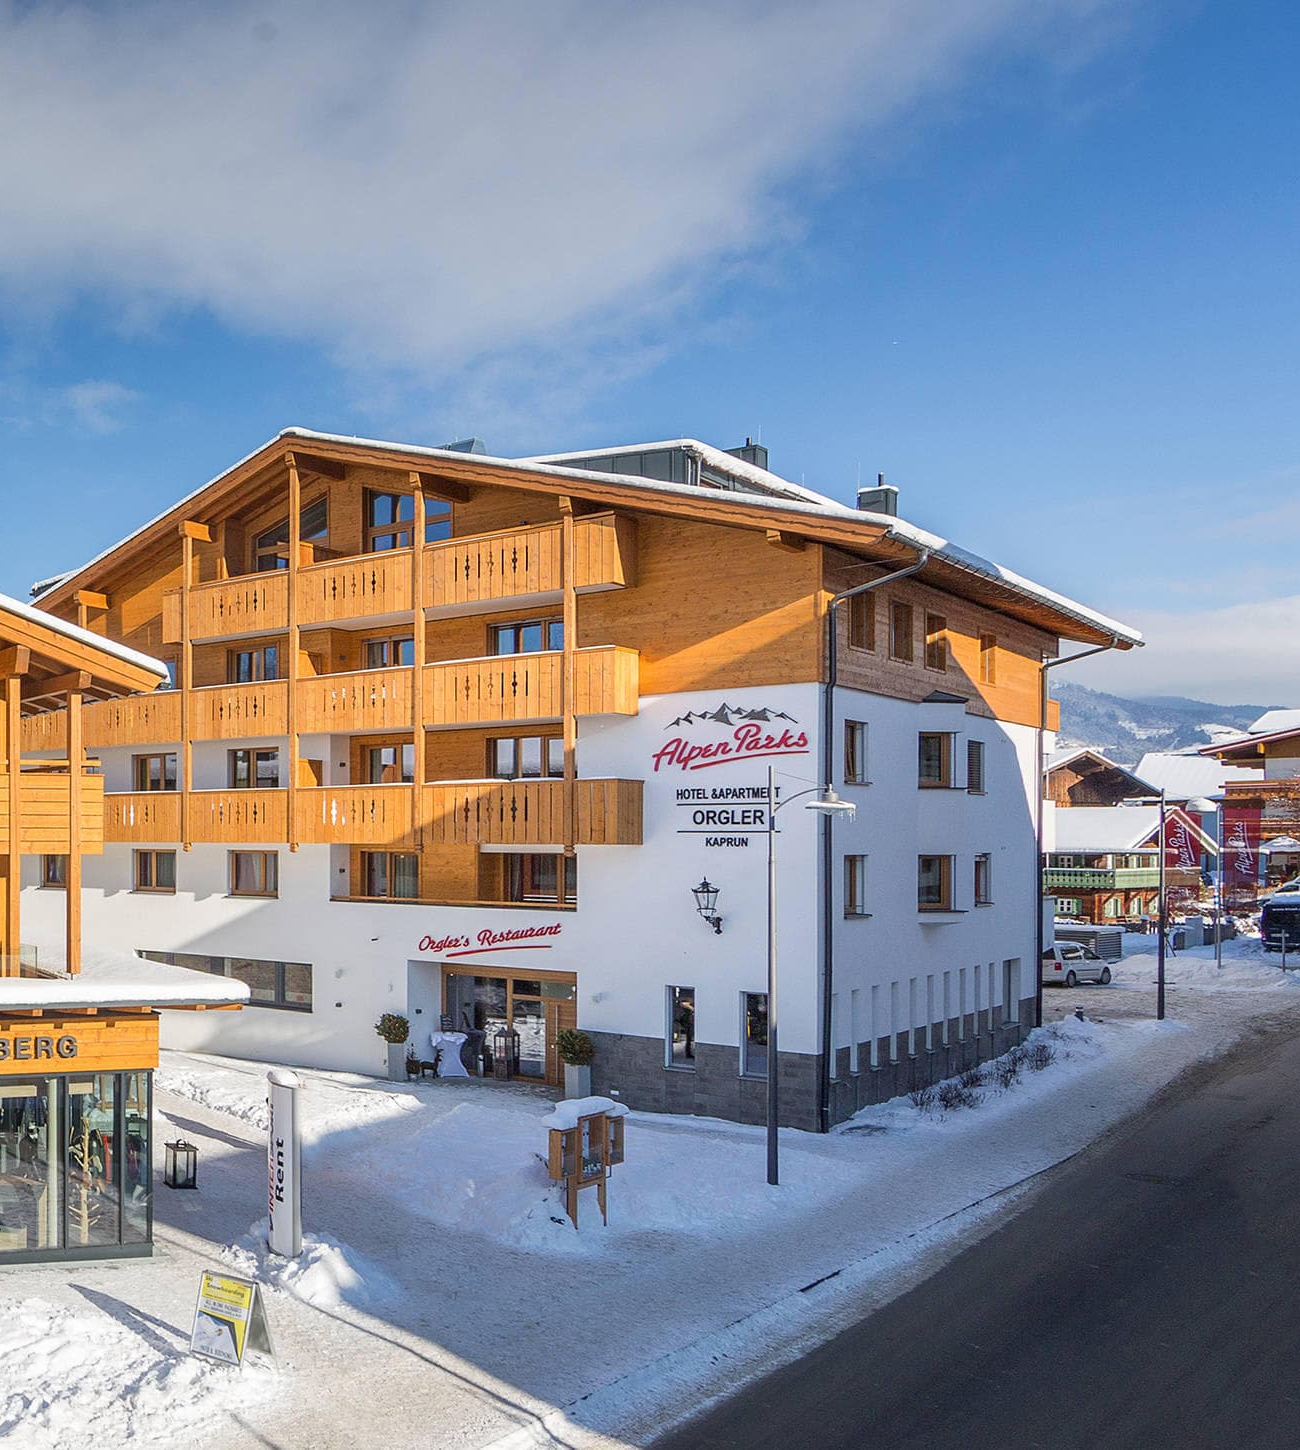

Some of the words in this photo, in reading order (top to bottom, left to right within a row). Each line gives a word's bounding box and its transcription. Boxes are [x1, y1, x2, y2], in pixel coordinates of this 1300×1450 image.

[676, 788, 708, 800] HOTEL
[692, 809, 764, 825] ORGLER
[705, 837, 748, 847] KAPRUN
[418, 935, 470, 952] Orgler's
[477, 923, 562, 946] Restaurant
[275, 1137, 285, 1203] Rent
